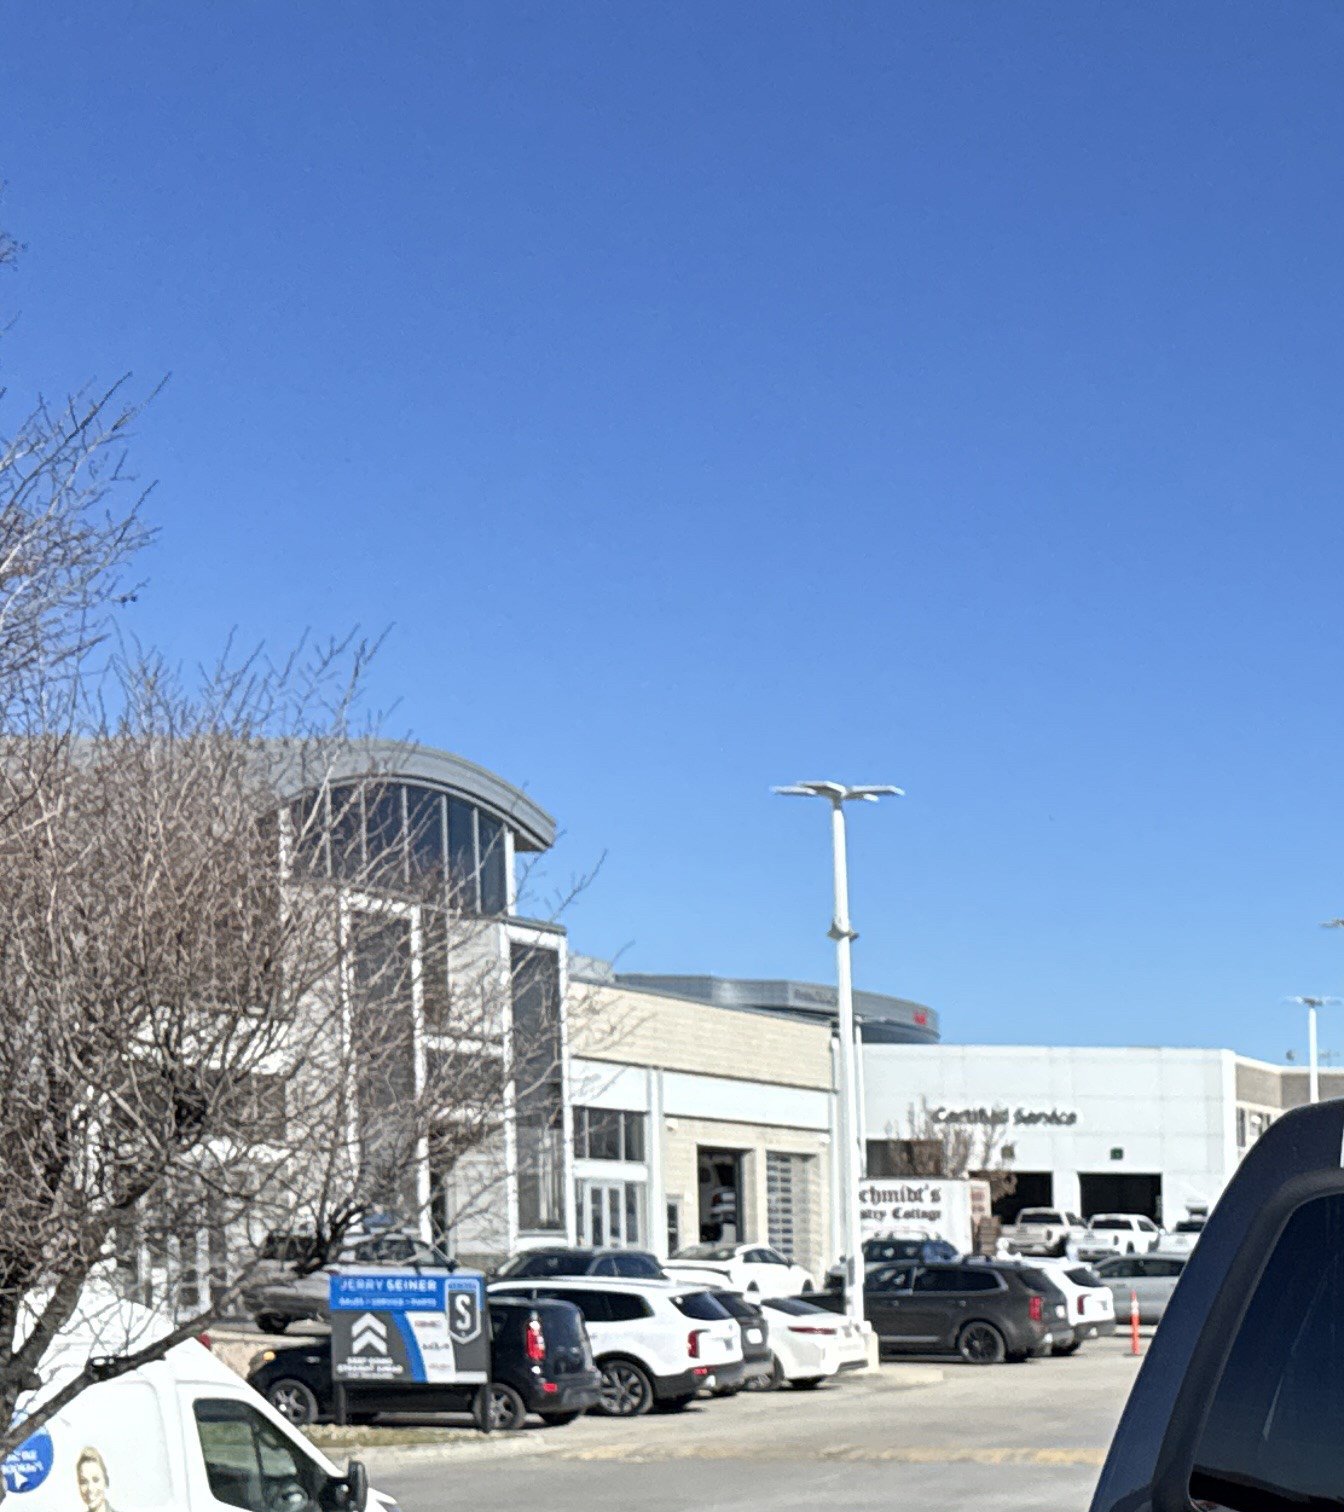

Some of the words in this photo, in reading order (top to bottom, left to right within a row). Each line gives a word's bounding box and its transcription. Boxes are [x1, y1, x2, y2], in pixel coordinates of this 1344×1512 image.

[1014, 1107, 1077, 1125] Service
[858, 1185, 942, 1204] chmidt's
[340, 1279, 383, 1292] JERRY
[386, 1279, 437, 1292] SEINER
